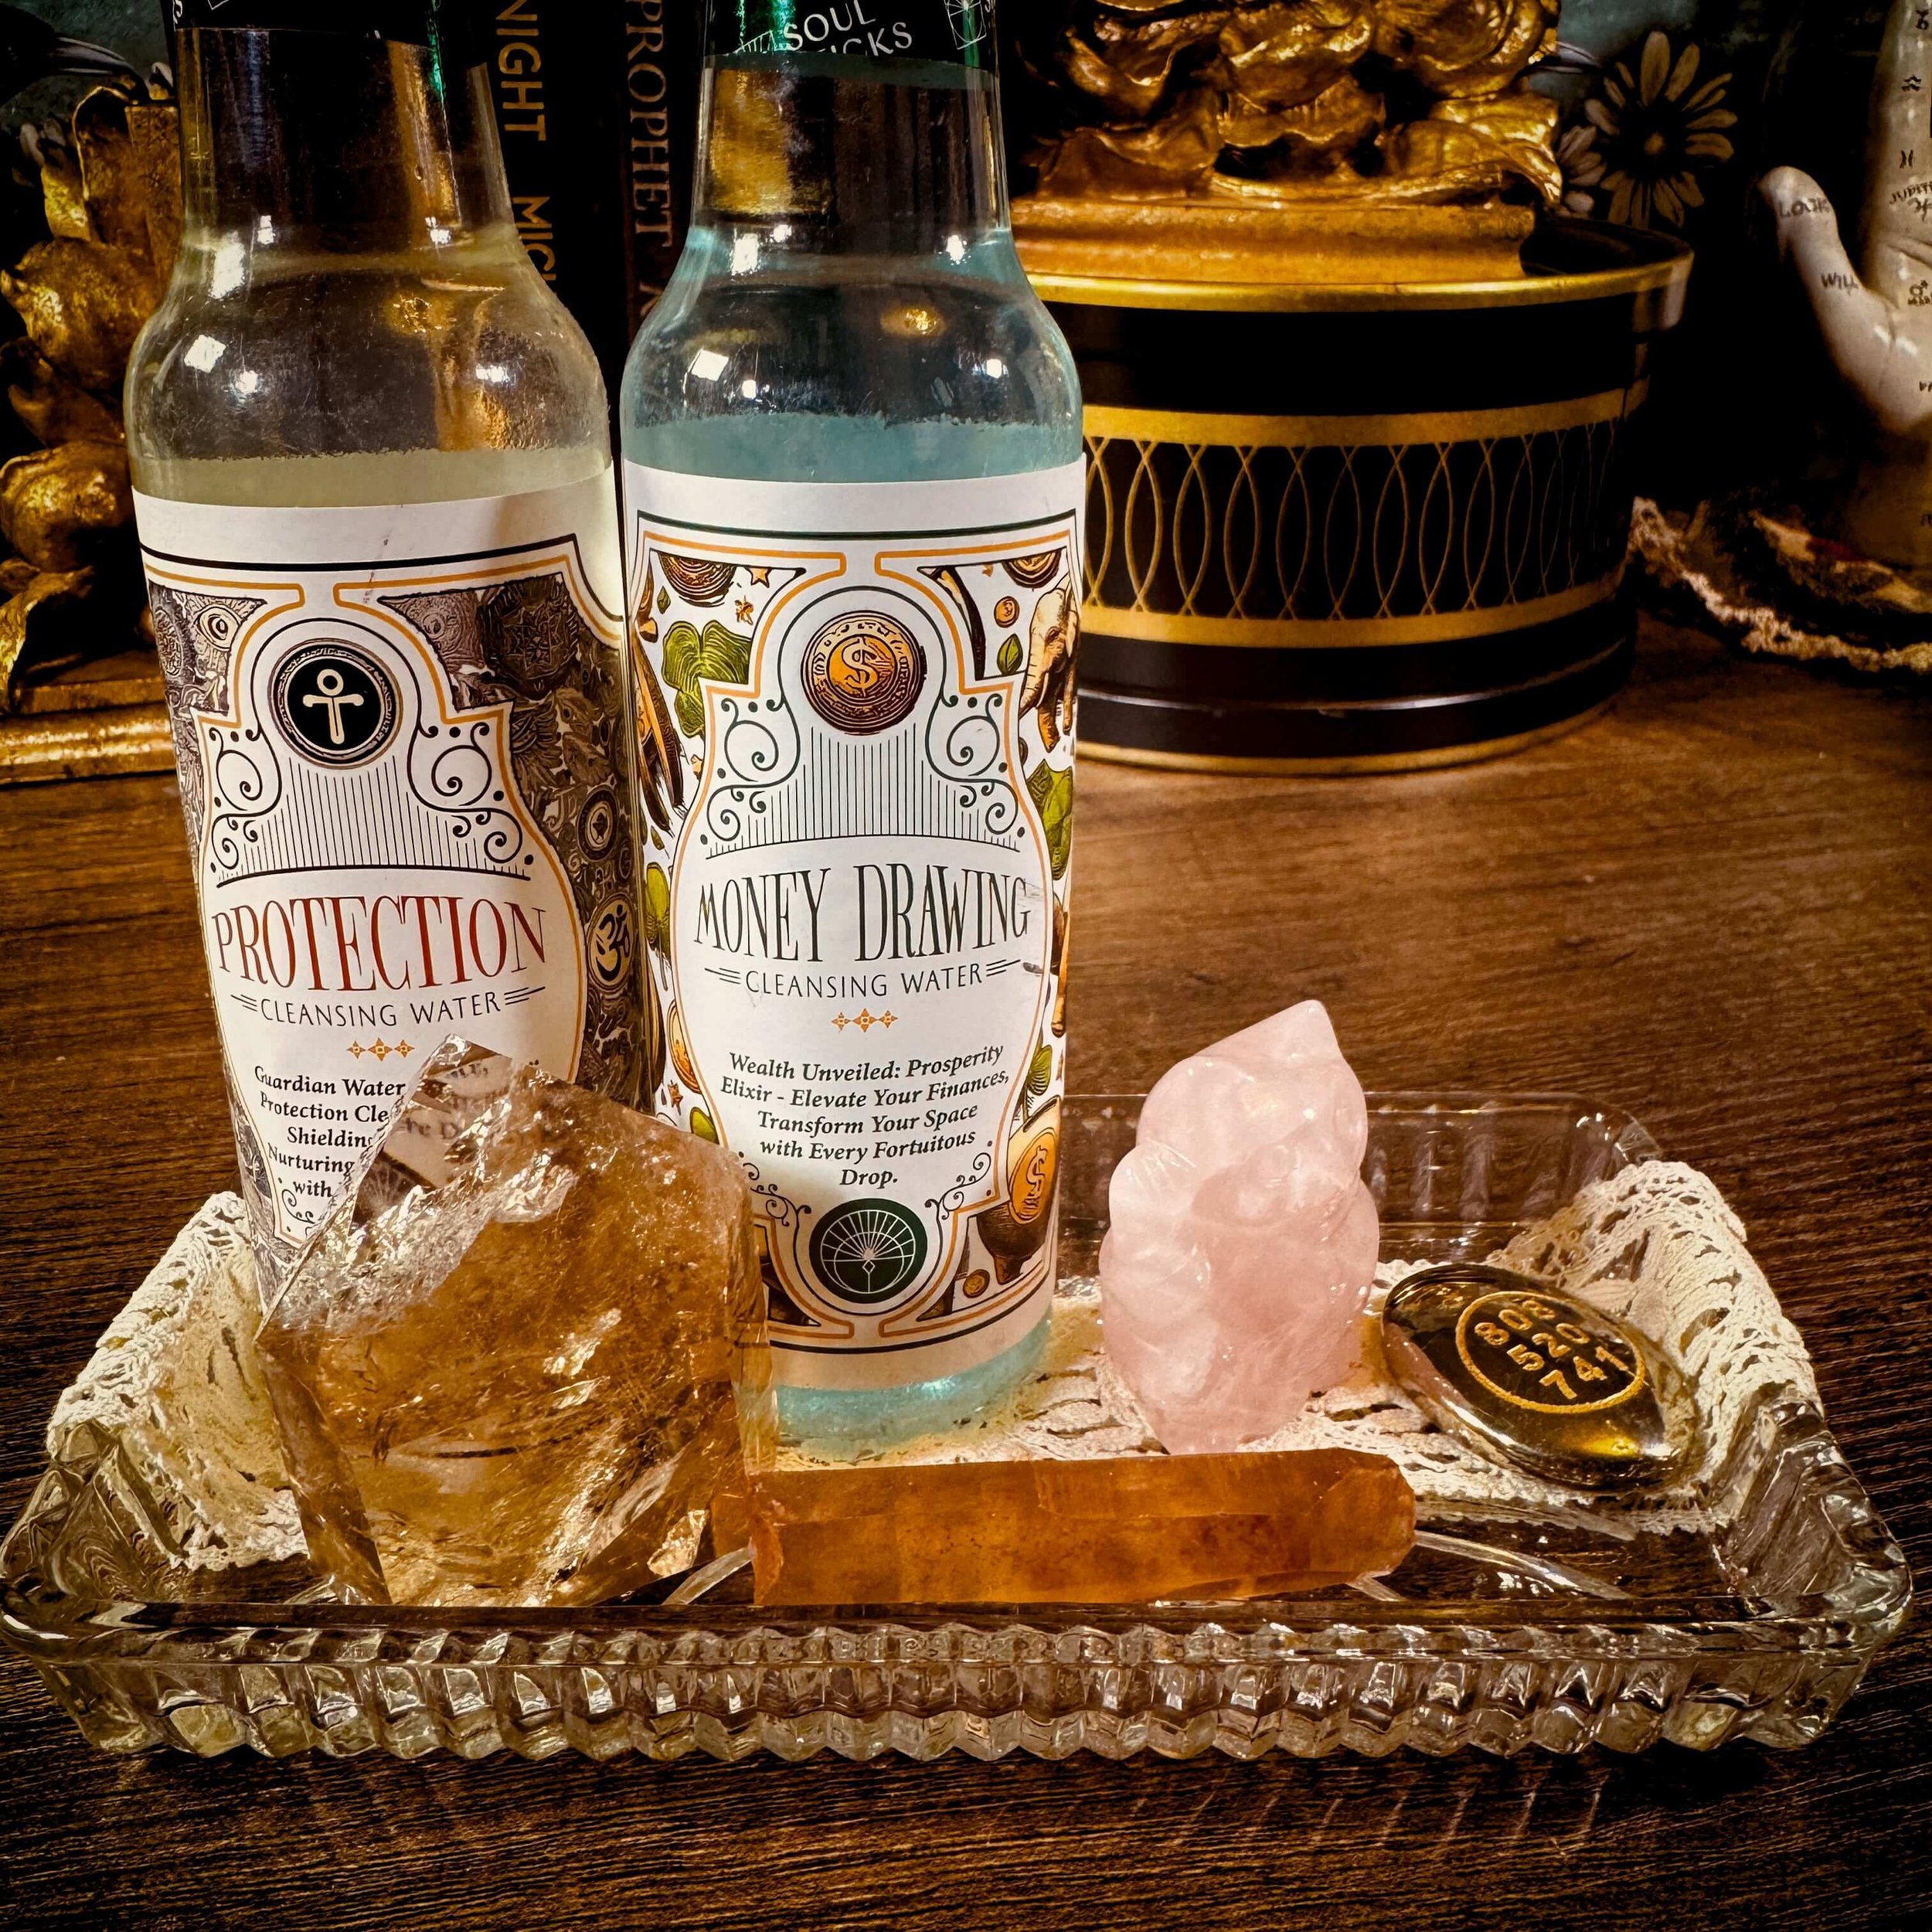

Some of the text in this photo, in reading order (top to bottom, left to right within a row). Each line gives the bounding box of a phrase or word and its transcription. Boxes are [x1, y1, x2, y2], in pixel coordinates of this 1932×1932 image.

[782, 0, 876, 52] SOUL
[625, 0, 674, 248] PROPHET
[512, 196, 557, 281] MIC
[693, 863, 1032, 963] MONEY DRAWING
[211, 894, 546, 992] PROTECTION
[745, 962, 983, 998] CLEANSING WATER
[260, 991, 502, 1027] CLEANSING WATER
[254, 1066, 406, 1097] Guardian Water
[729, 1044, 1004, 1083] Wealth Unveiled: Prosperity
[720, 1076, 773, 1103] Elixir
[789, 1089, 867, 1107] Elevate
[873, 1088, 923, 1107] Your
[927, 1070, 1009, 1102] Finances,
[260, 1092, 349, 1123] Protection
[758, 1104, 978, 1138] Transform Your Space
[267, 1142, 355, 1178] Nurturing
[760, 1129, 976, 1165] with Every Fortuitous
[293, 1179, 332, 1199] with
[838, 1168, 899, 1190] Drop.
[1506, 1322, 1591, 1372] 520
[1538, 1345, 1629, 1400] 741
